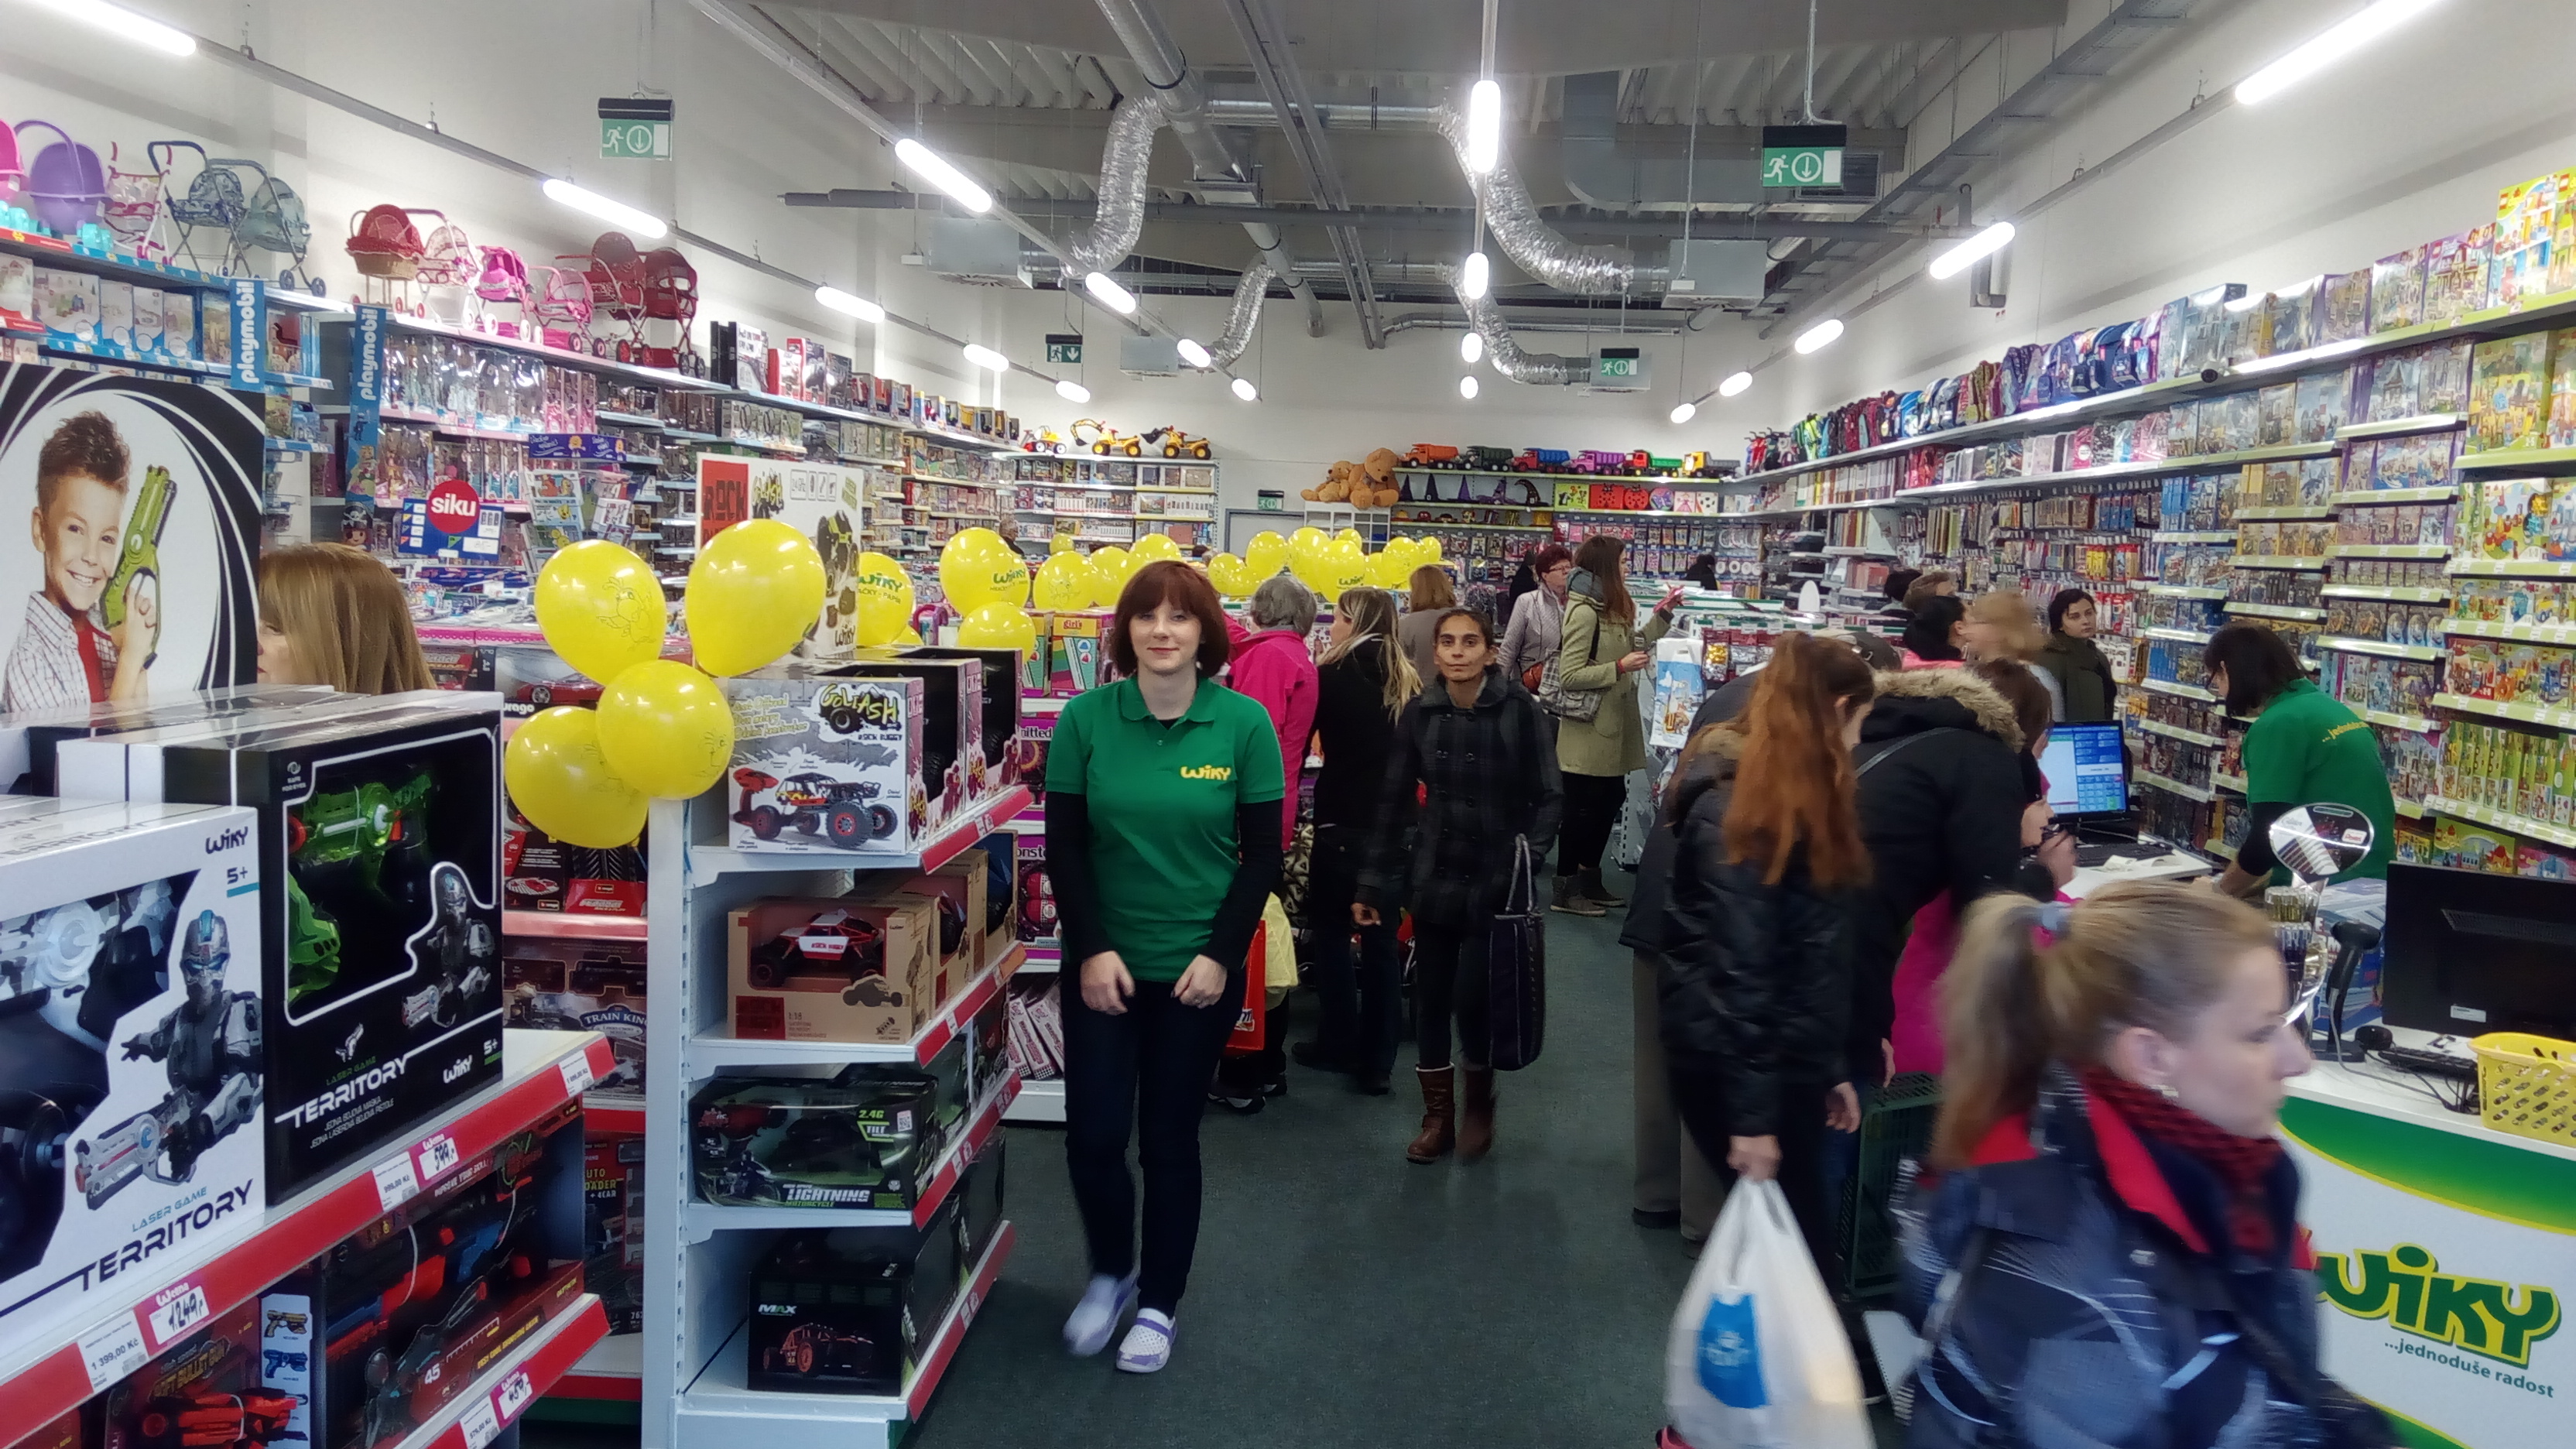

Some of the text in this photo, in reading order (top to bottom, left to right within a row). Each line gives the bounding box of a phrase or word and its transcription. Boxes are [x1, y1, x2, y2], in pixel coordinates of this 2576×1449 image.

[235, 281, 259, 383] playmobil
[358, 308, 379, 401] playmobil
[430, 493, 477, 517] siku
[820, 683, 899, 724] GOLIASH
[226, 867, 248, 884] 5+
[584, 1012, 647, 1026] TRAIN KIN
[483, 1039, 498, 1055] 5+
[326, 1056, 377, 1086] LASER GAME
[275, 1056, 409, 1129] TERRITORY
[132, 1185, 208, 1233] LASER GAME
[786, 1188, 871, 1202] LIGHTNING
[76, 1177, 254, 1293] TERRITORY
[759, 1303, 797, 1314] MAX
[98, 1345, 128, 1367] 399,00
[126, 1337, 140, 1350] Kč
[424, 1364, 440, 1385] 45
[2384, 1338, 2554, 1398] ...jednoduše radost
